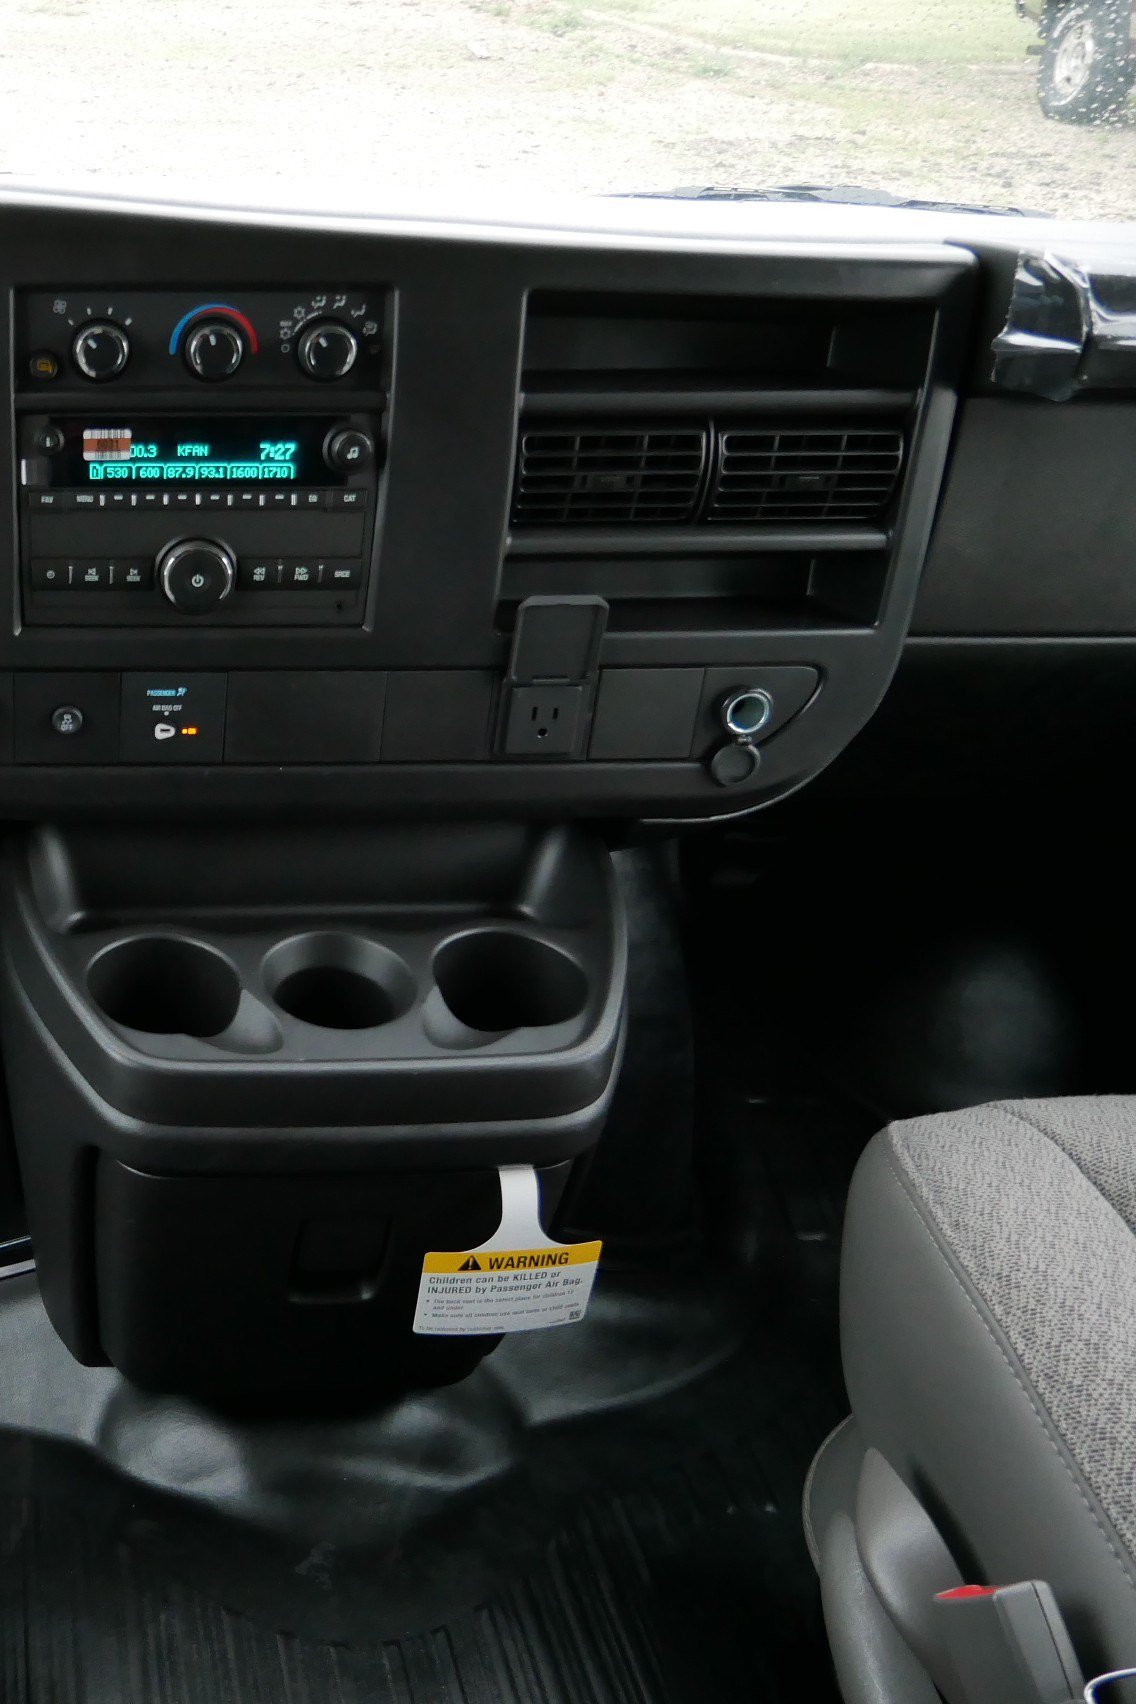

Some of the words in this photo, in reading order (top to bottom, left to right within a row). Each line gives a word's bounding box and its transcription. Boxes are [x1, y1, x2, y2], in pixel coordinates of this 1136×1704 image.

[130, 445, 158, 458] 00.3
[176, 443, 209, 457] KFAN
[259, 443, 296, 460] 7:27
[106, 467, 129, 479] 530
[139, 466, 160, 479] 600
[167, 466, 194, 479] 87.9
[200, 467, 225, 479] 93.1
[231, 467, 258, 479] 1600
[263, 467, 288, 479] 1710
[343, 494, 357, 503] CAT
[488, 1251, 569, 1271] WARNING
[427, 1286, 472, 1295] INJURED
[475, 1285, 487, 1295] by
[490, 1282, 542, 1294] Passenger
[544, 1279, 560, 1289] Air
[562, 1276, 583, 1287] Bag.
[429, 1276, 473, 1285] Children
[475, 1276, 494, 1285] can
[497, 1273, 510, 1283] be
[513, 1271, 548, 1282] KILLED
[550, 1271, 561, 1279] or
